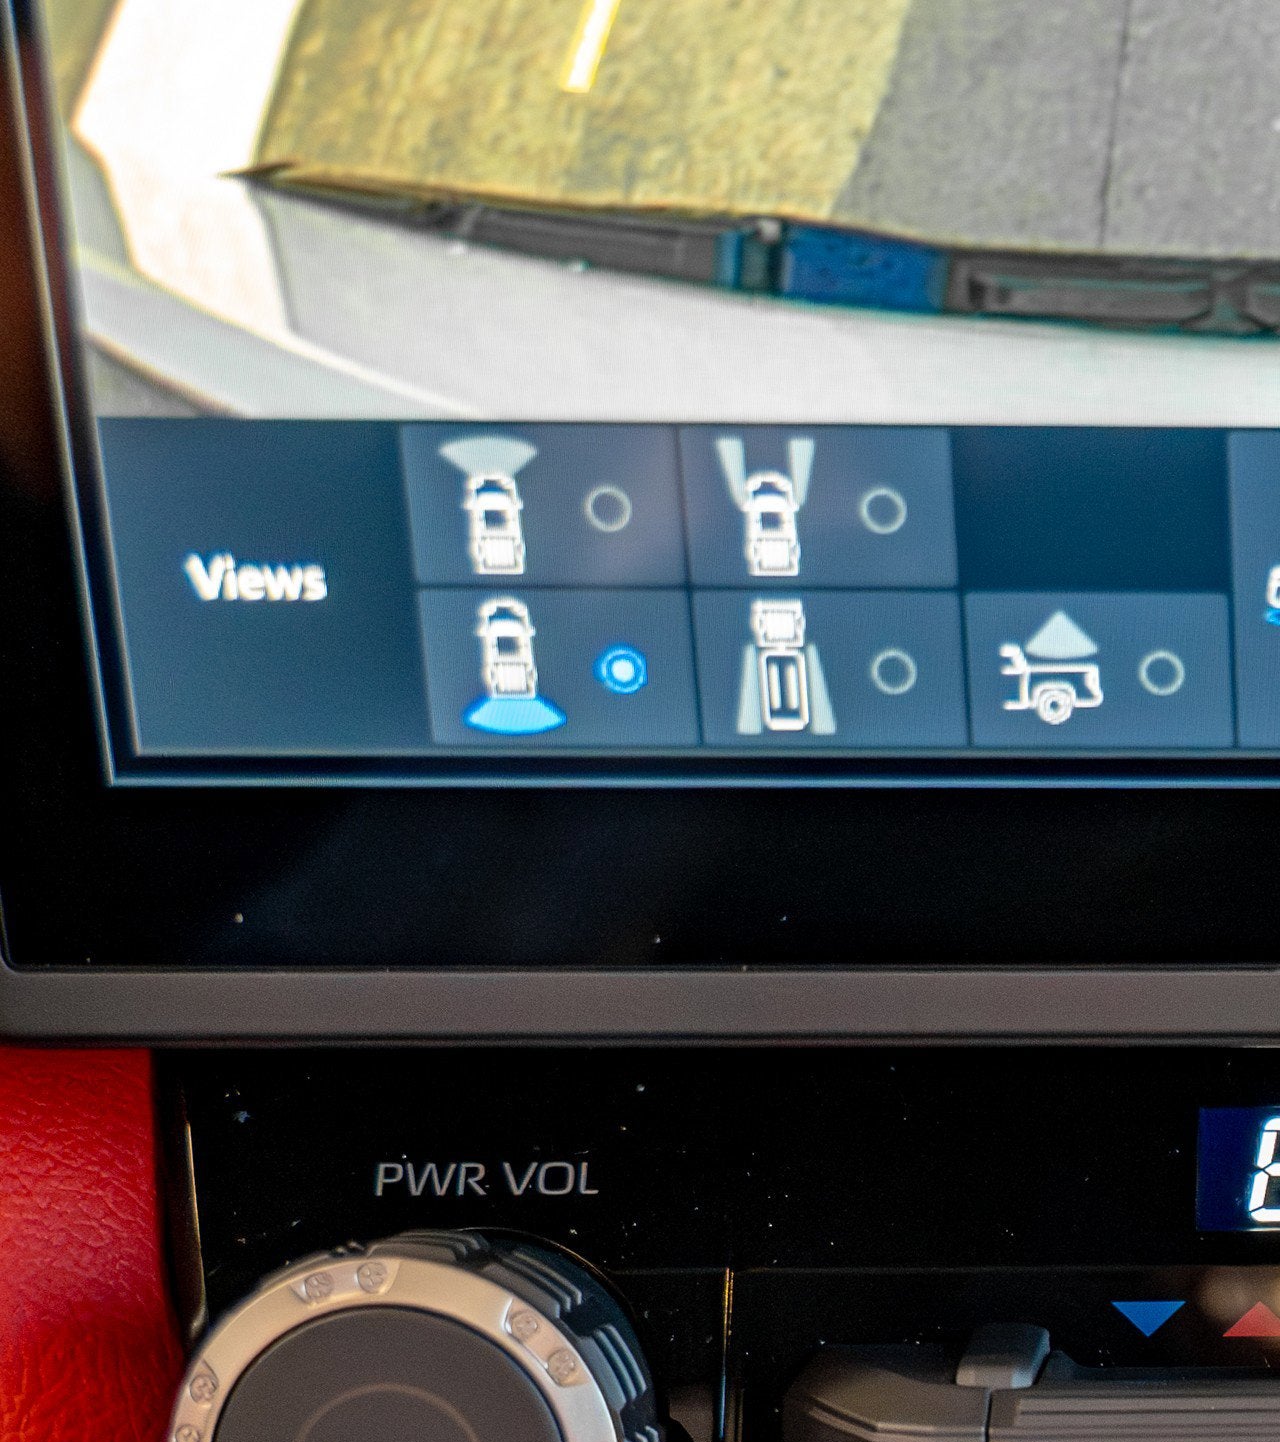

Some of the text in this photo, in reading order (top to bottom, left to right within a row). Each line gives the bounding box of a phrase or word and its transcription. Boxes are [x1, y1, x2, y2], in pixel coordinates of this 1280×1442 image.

[184, 551, 327, 602] Views
[374, 1161, 600, 1196] PWR VOL
